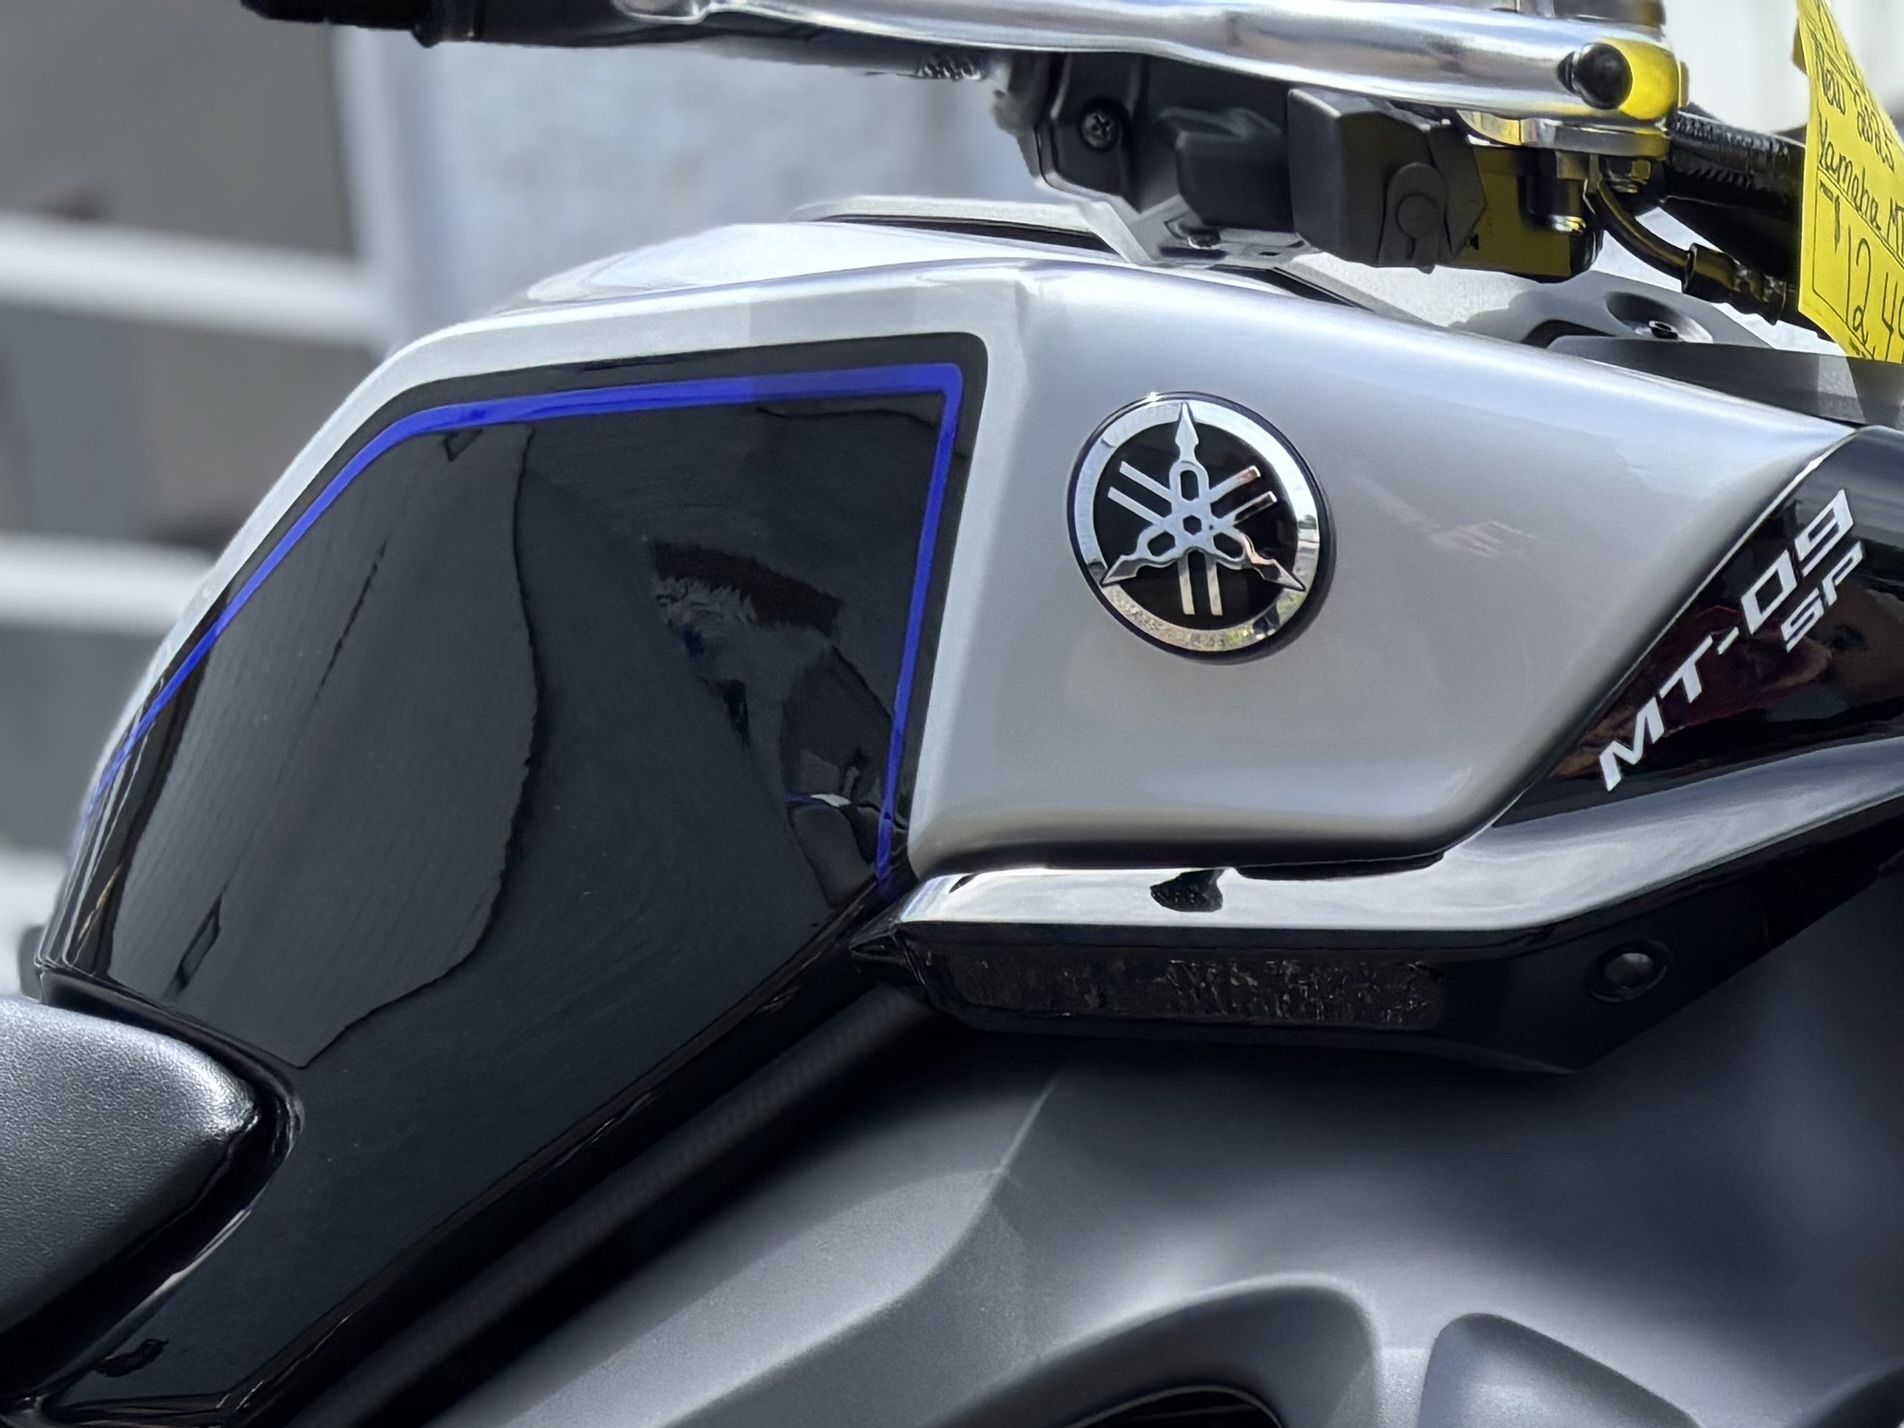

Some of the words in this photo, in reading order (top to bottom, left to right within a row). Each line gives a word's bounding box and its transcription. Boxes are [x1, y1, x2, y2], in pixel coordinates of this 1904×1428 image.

[1818, 114, 1881, 233] Yamaha
[1599, 488, 1854, 792] MT-09
[1780, 540, 1866, 653] SP
